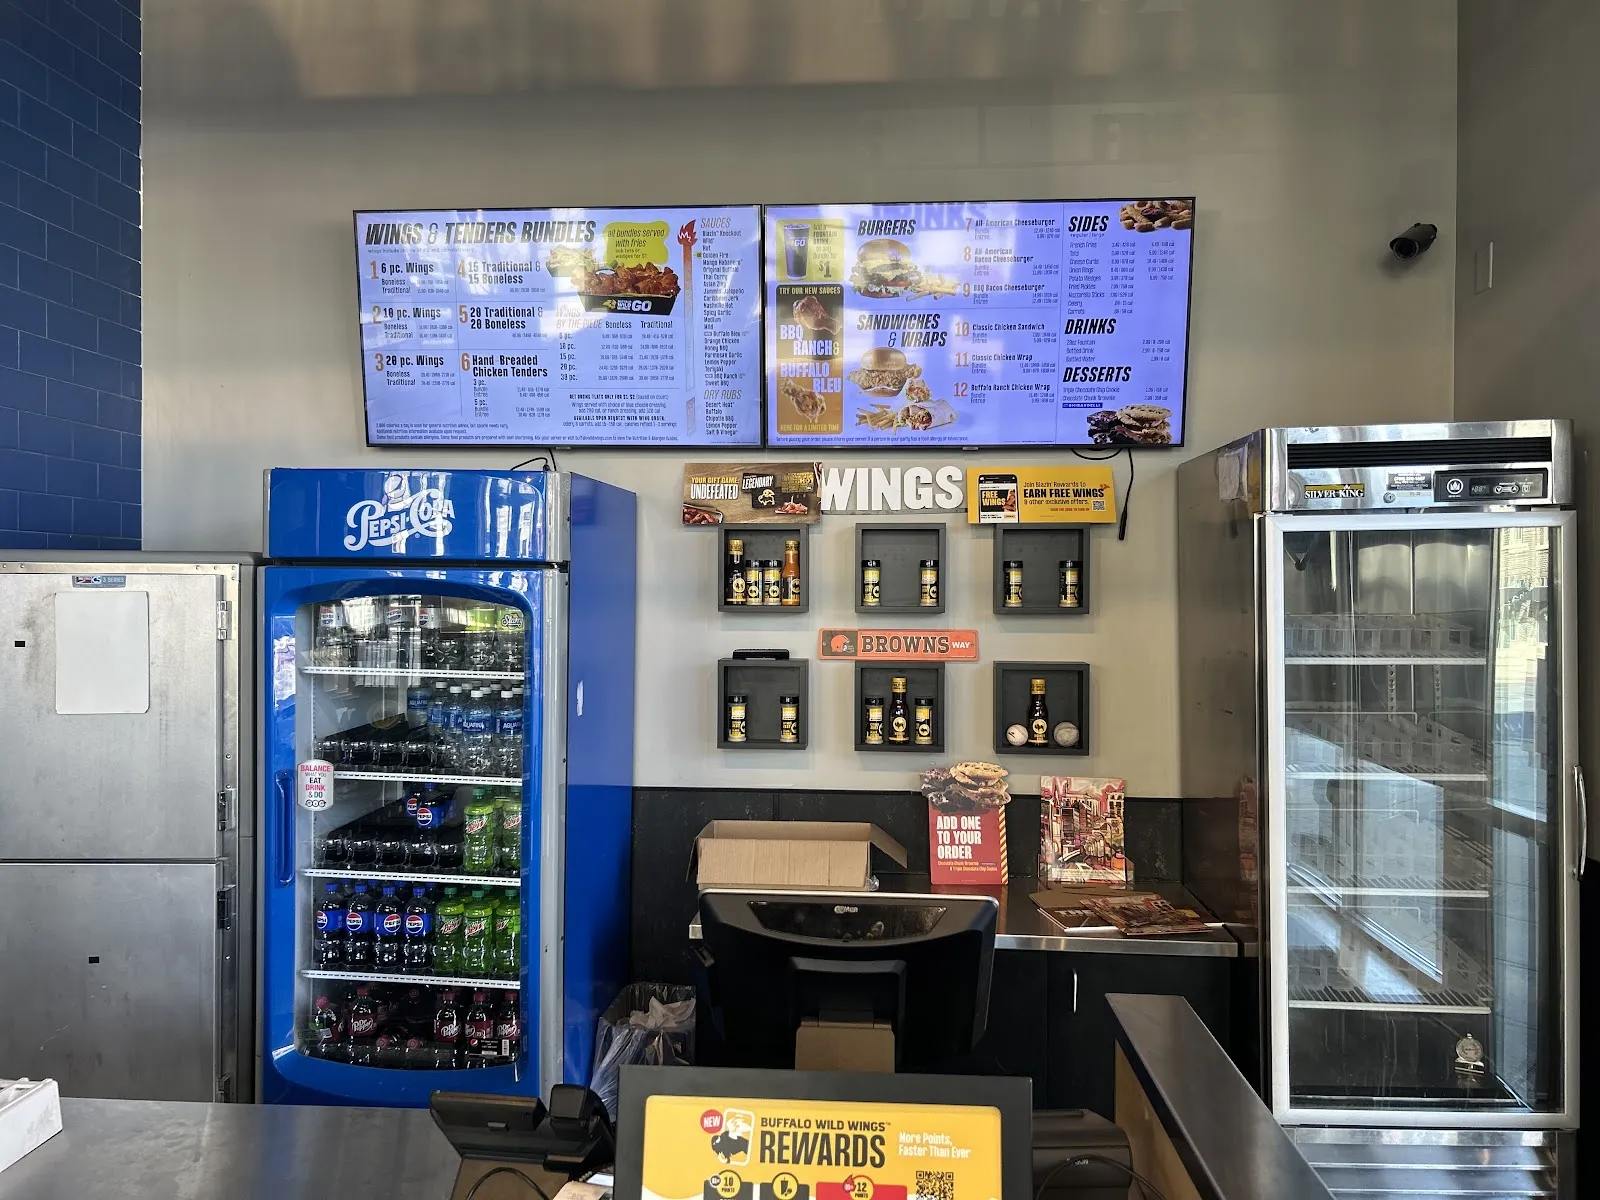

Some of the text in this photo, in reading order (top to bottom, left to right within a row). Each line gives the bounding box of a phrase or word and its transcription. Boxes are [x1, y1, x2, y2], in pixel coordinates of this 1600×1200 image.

[700, 217, 732, 229] SAUCES
[857, 219, 917, 236] BURGERS
[965, 217, 972, 232] 7
[1014, 218, 1055, 228] Cheeseburger
[1068, 215, 1109, 232] SIDES
[365, 220, 597, 246] WINGS & TENDERS BUNDLES
[617, 228, 641, 238] bundles
[642, 229, 665, 238] served
[615, 239, 647, 248] with fries
[964, 246, 971, 261] 8
[992, 256, 1034, 264] Cheeseburger
[370, 260, 379, 280] 1
[381, 262, 435, 276] 6 pc. Wings
[457, 259, 467, 278] 4
[468, 262, 478, 273] 15
[482, 260, 533, 272] Traditional
[381, 278, 406, 286] Boneless
[468, 273, 524, 285] 15 Boneless
[382, 286, 411, 294] Traditional
[779, 286, 841, 295] TRY OUR NEW SAUCES
[963, 282, 971, 298] 9
[1004, 283, 1045, 292] Cheeseburger
[470, 306, 482, 318] 20
[485, 306, 535, 318] Traditional
[632, 299, 652, 311] GO
[372, 305, 382, 324] 2
[397, 309, 411, 320] pc.
[413, 307, 442, 320] Wings
[459, 305, 469, 324] 5
[703, 309, 717, 317] Spicy
[384, 323, 408, 331] Boneless
[470, 318, 526, 330] 20 Boneless
[605, 320, 673, 329] Boneless Traditional
[857, 313, 941, 331] SANDWICHES
[955, 321, 970, 337] 10
[972, 323, 1045, 331] Classic Chicken Sandwich
[1064, 318, 1117, 335] DRINKS
[385, 331, 414, 339] Traditional
[780, 324, 803, 342] BBQ
[888, 332, 948, 348] & WRAPS
[375, 352, 385, 371] 3
[386, 355, 444, 369] 20 pc. Wings
[461, 352, 471, 371] 6
[955, 352, 969, 368] 11
[1016, 354, 1033, 362] Wrap
[386, 370, 411, 378] Boneless
[472, 366, 548, 378] Chicken Tenders
[780, 362, 830, 378] BUFFALO
[1062, 366, 1132, 383] DESSERTS
[813, 377, 842, 393] BLEU
[953, 382, 968, 397] 12
[1011, 383, 1034, 391] Chicken
[1034, 383, 1051, 392] Wrap
[704, 389, 743, 400] DRY RUBS
[691, 476, 707, 484] YOUR
[707, 476, 720, 484] GIFT
[742, 475, 774, 490] LEGENDARY
[690, 483, 739, 500] UNDEFEATED
[820, 465, 964, 511] WINGS
[982, 490, 999, 499] FREE
[1023, 488, 1104, 498] EARN FREE WINGS
[1304, 486, 1365, 499] SILVER KING
[982, 498, 1006, 506] WINGS
[860, 635, 971, 655] BROWNS WAY
[936, 816, 982, 830] ADD ONE
[936, 830, 982, 845] TO YOUR
[937, 845, 973, 860] ORDER
[703, 1114, 721, 1128] NEW
[760, 1117, 812, 1129] BUFFALO
[815, 1119, 845, 1131] WILD
[898, 1132, 953, 1146] More Points,
[759, 1130, 886, 1169] REWARDS
[898, 1145, 972, 1160] Faster Than Ever
[723, 1176, 734, 1187] 10
[857, 1181, 868, 1193] 12
